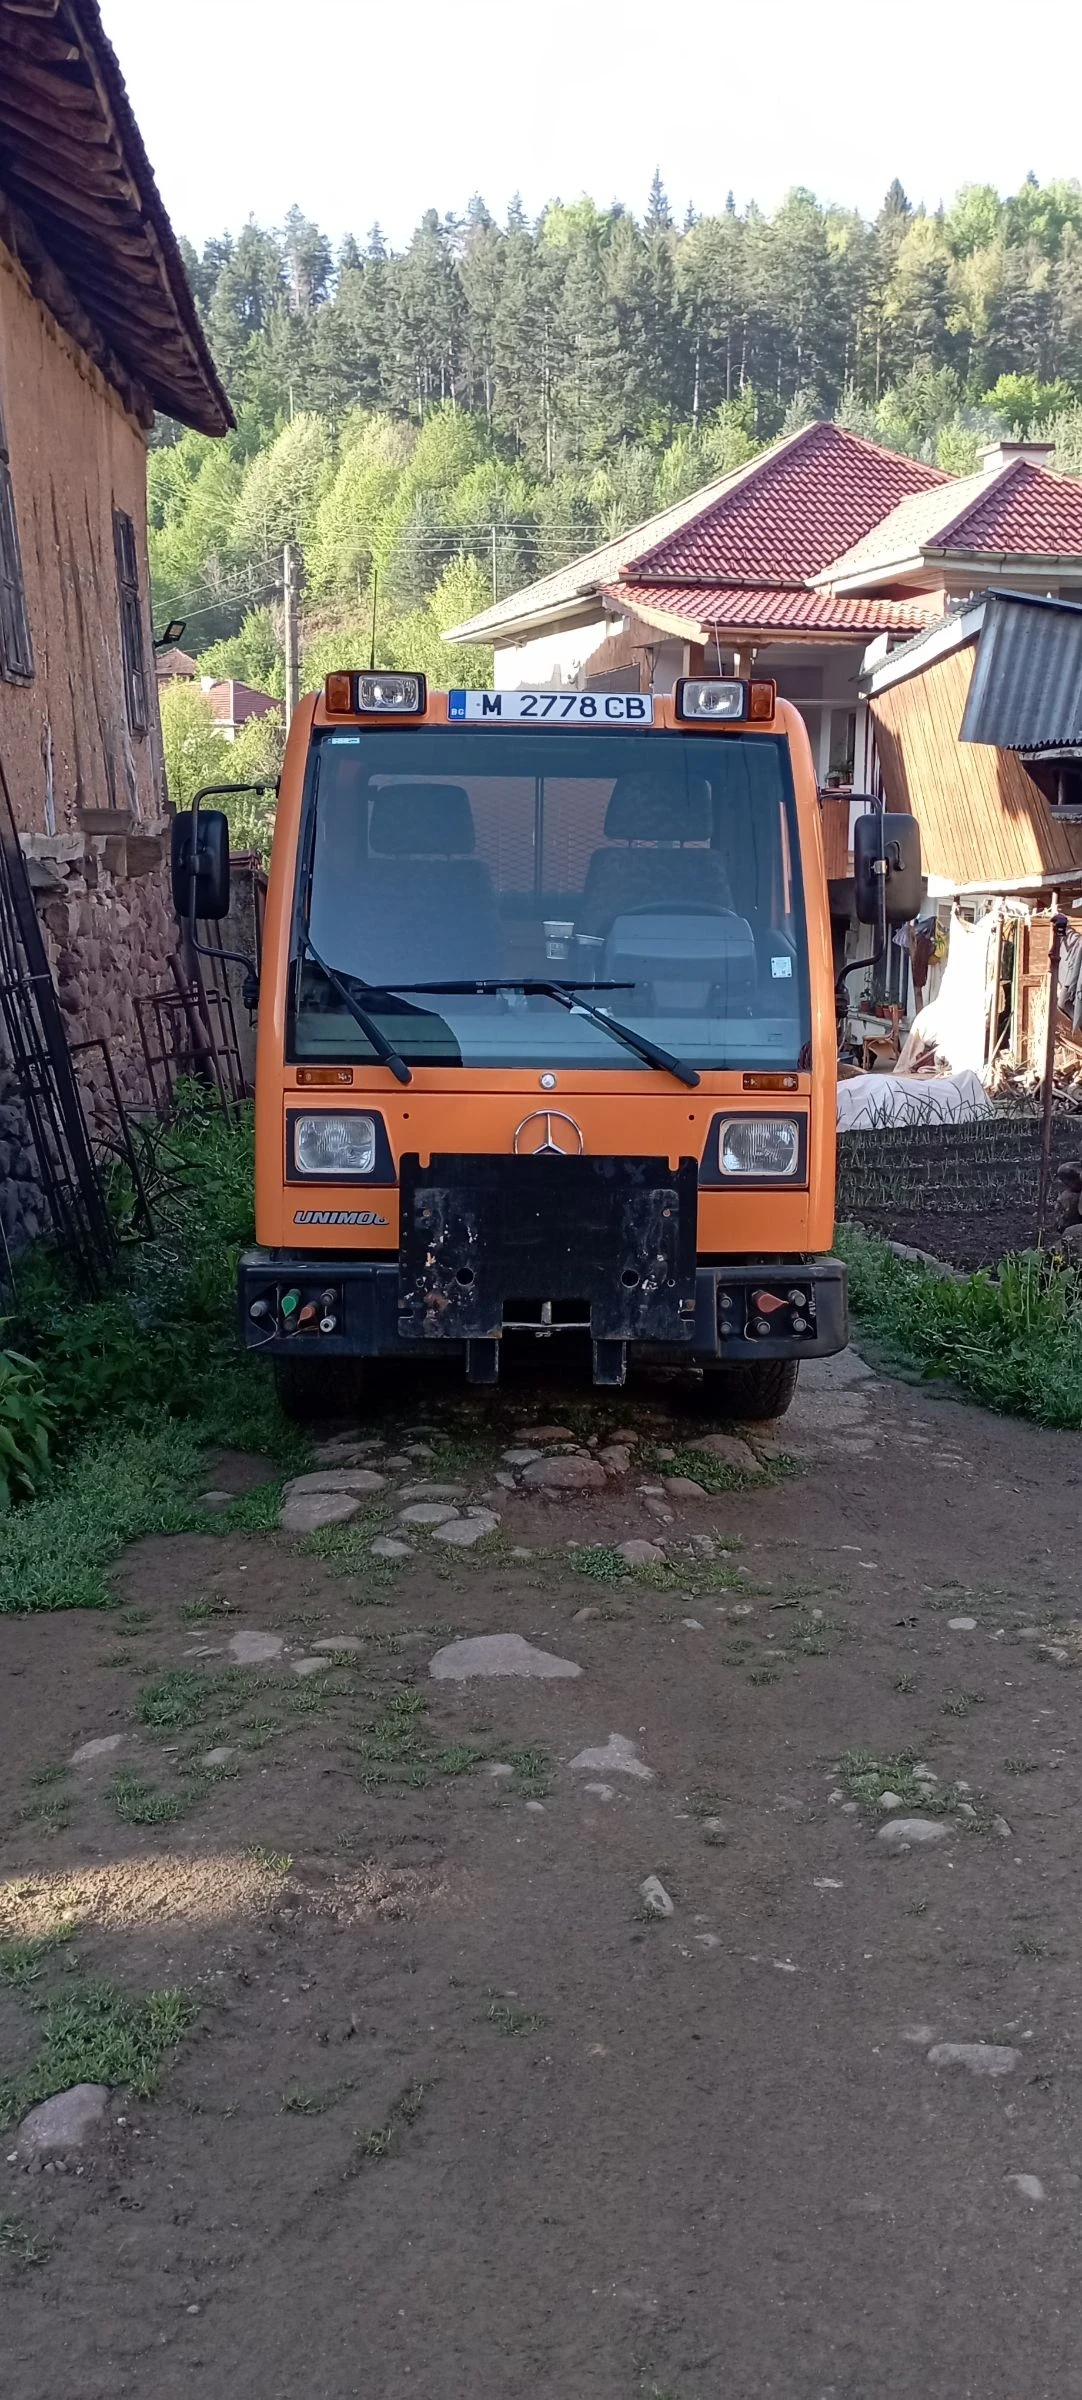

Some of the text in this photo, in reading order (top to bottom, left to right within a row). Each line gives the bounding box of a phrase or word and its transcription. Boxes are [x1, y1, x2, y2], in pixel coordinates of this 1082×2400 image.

[451, 708, 464, 716] BG
[482, 694, 646, 719] M 2778 CB
